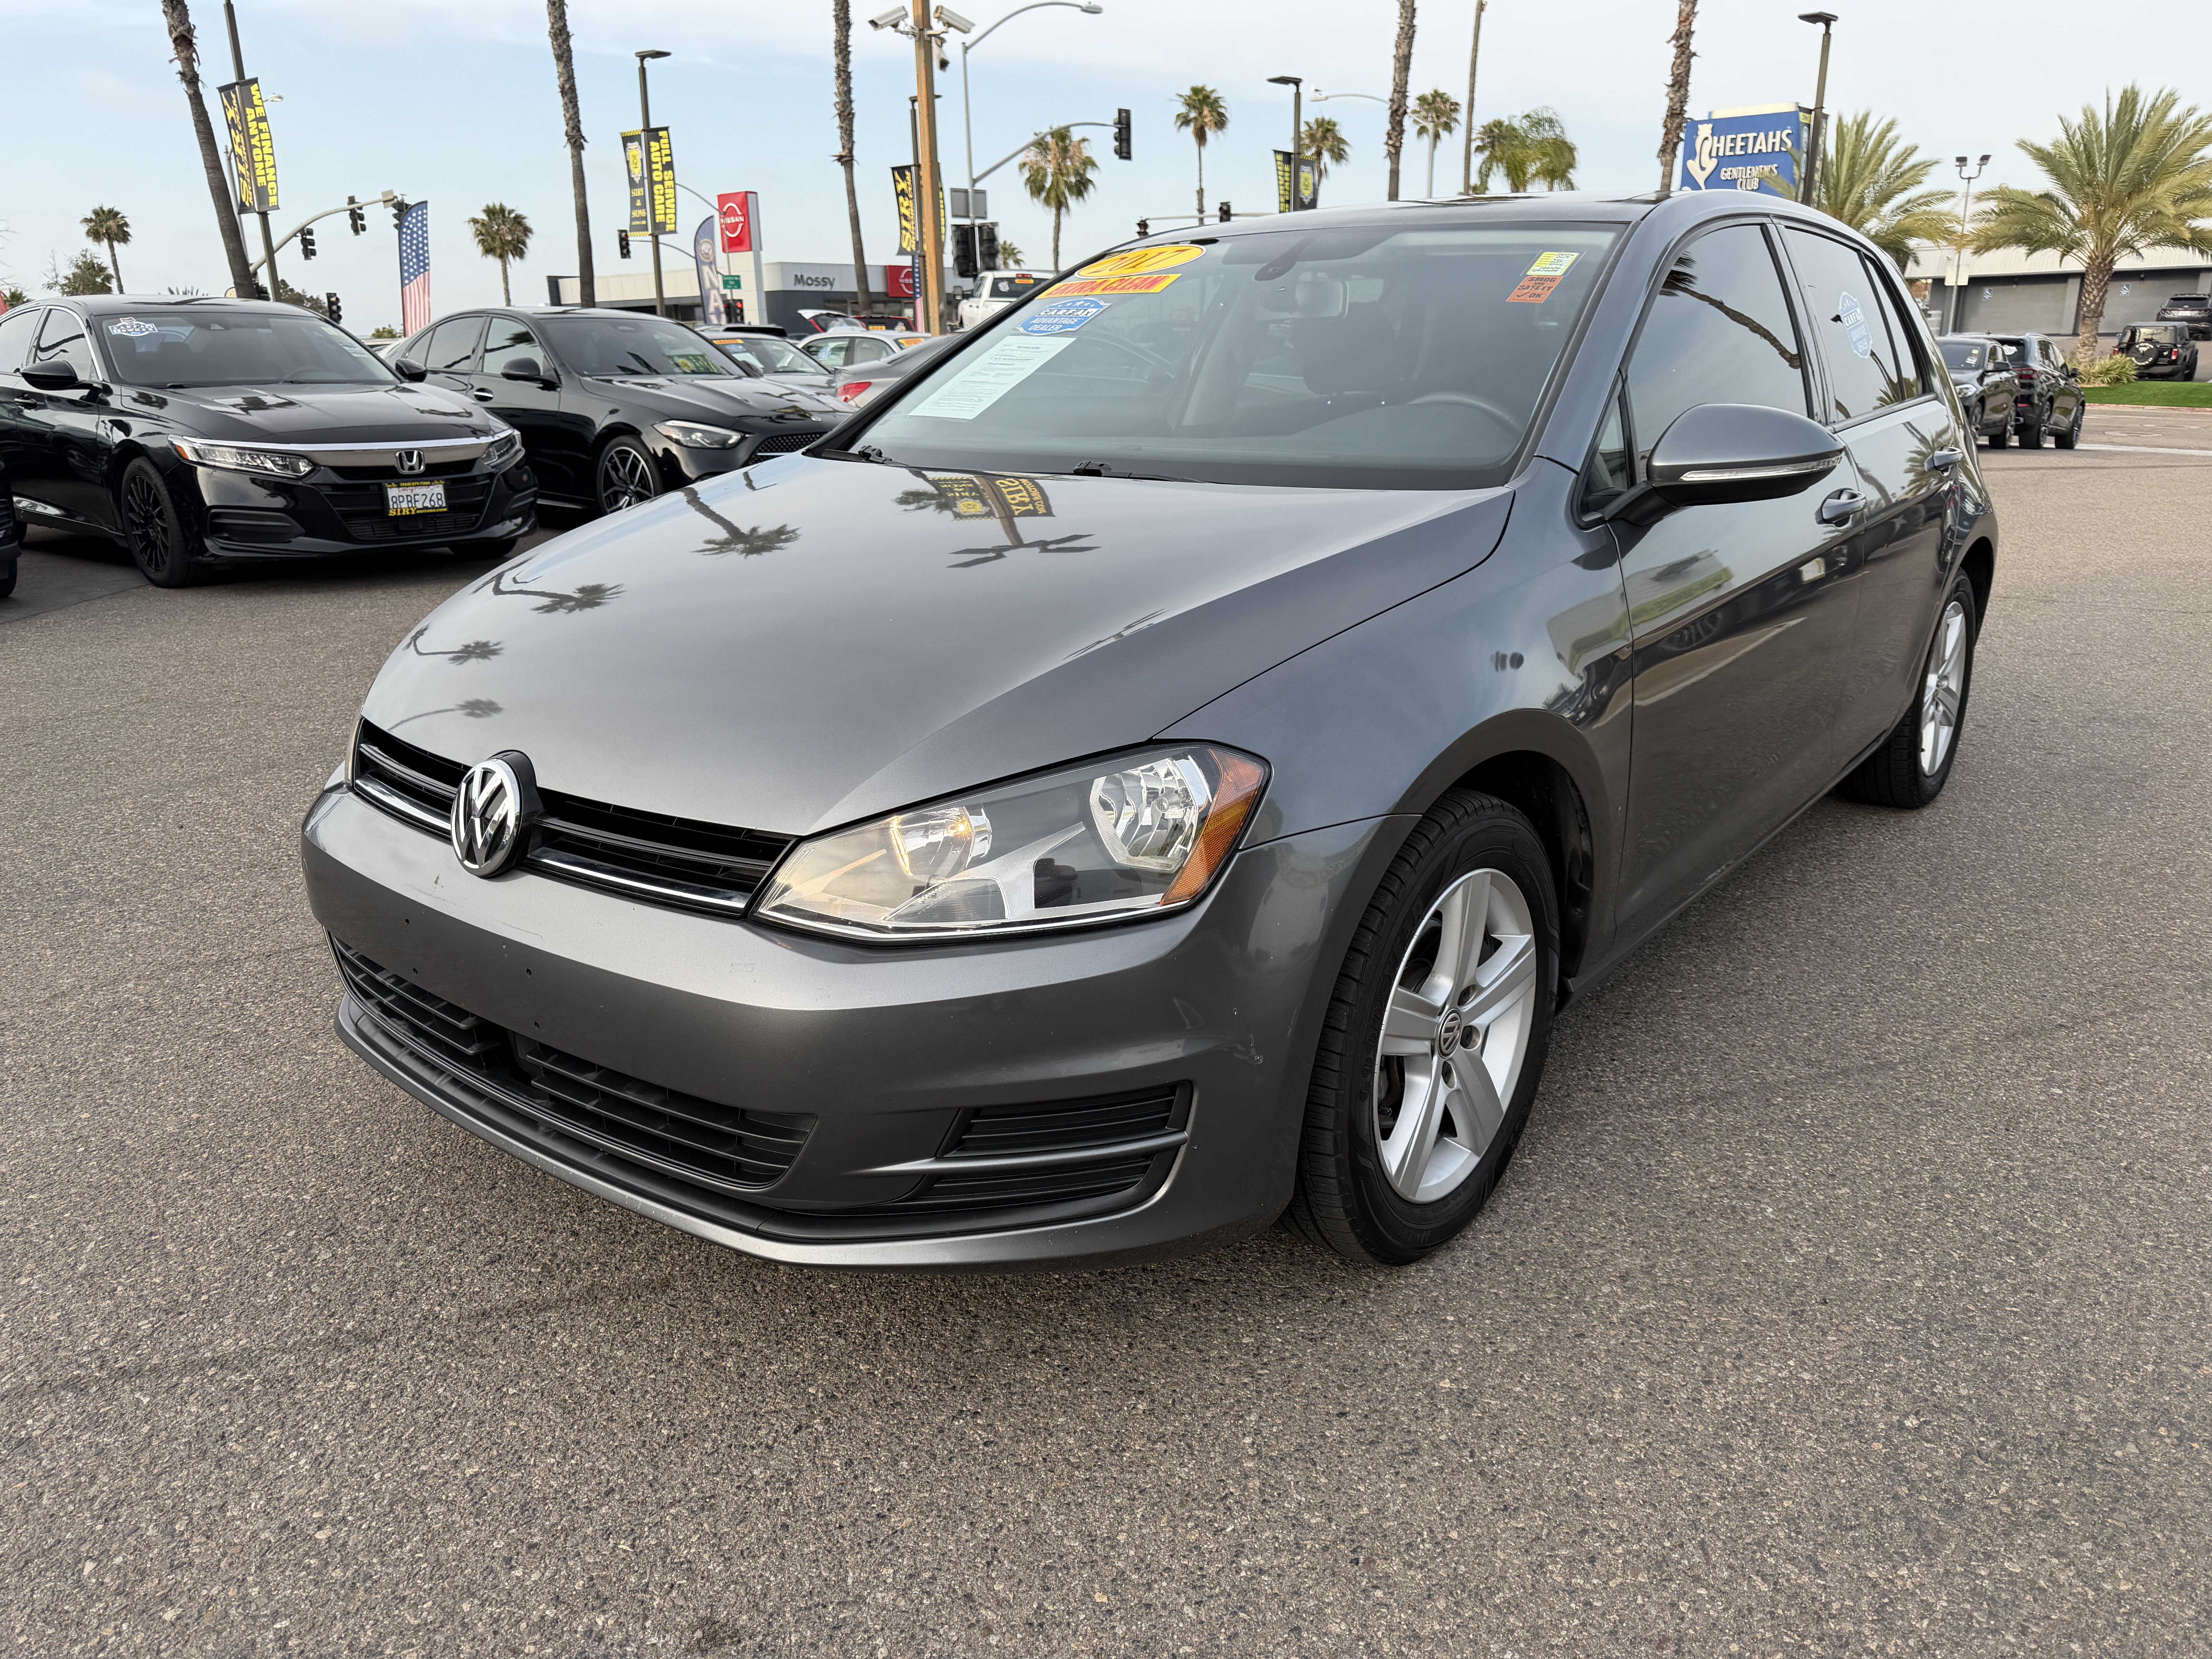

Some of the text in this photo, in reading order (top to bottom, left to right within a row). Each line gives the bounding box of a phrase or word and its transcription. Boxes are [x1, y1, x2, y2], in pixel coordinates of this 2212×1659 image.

[222, 93, 250, 208] SIRY
[246, 108, 267, 187] ANYONE
[251, 83, 278, 207] WE FINANCE
[649, 141, 665, 223] AUTO CARE
[658, 131, 676, 232] FULL SERVICE
[1736, 177, 1759, 190] CLUB
[720, 215, 744, 224] NISSAN
[894, 170, 911, 252] SIRY
[794, 274, 835, 290] Mossy
[1046, 275, 1170, 296] EXTRA CLEAN
[1091, 248, 1192, 273] 2017
[389, 508, 417, 516] SIRY
